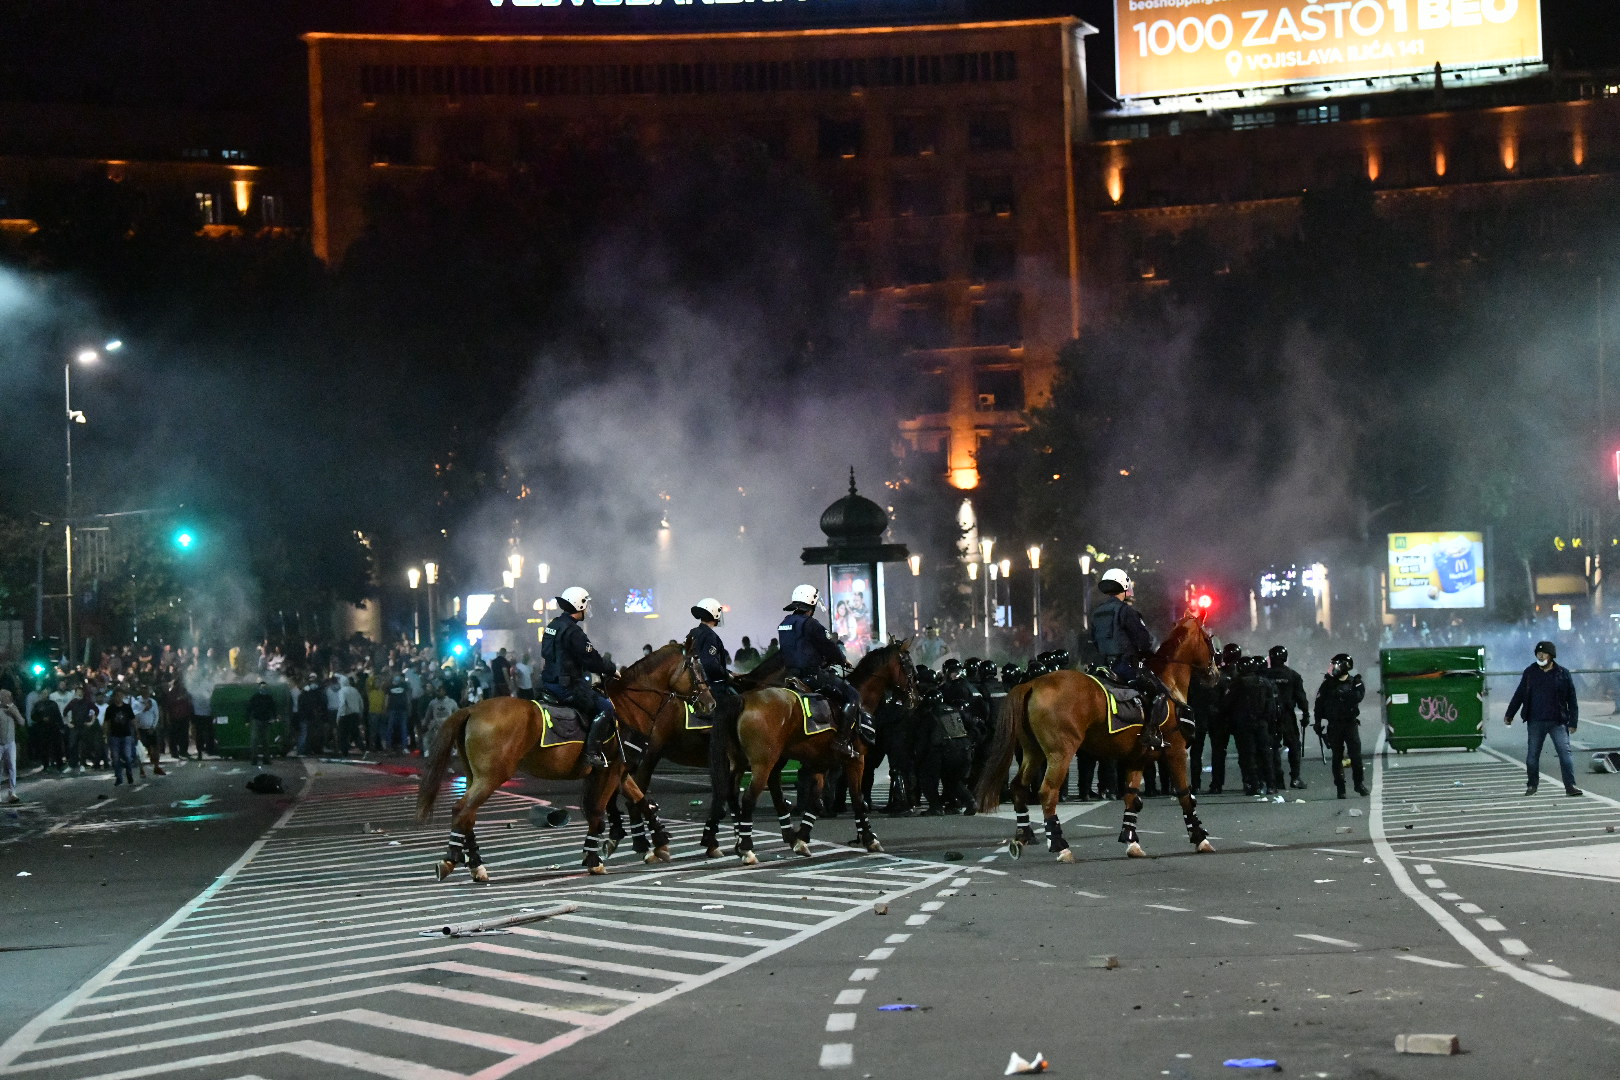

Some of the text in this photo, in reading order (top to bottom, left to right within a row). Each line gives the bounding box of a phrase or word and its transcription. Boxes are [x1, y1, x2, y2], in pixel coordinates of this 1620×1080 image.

[1132, 13, 1234, 57] 1000
[1241, 0, 1385, 47] ZAŠTO
[1417, 0, 1519, 30] BEO
[1245, 47, 1344, 71] VOJISLAVA
[1347, 39, 1396, 62] ILIĆA
